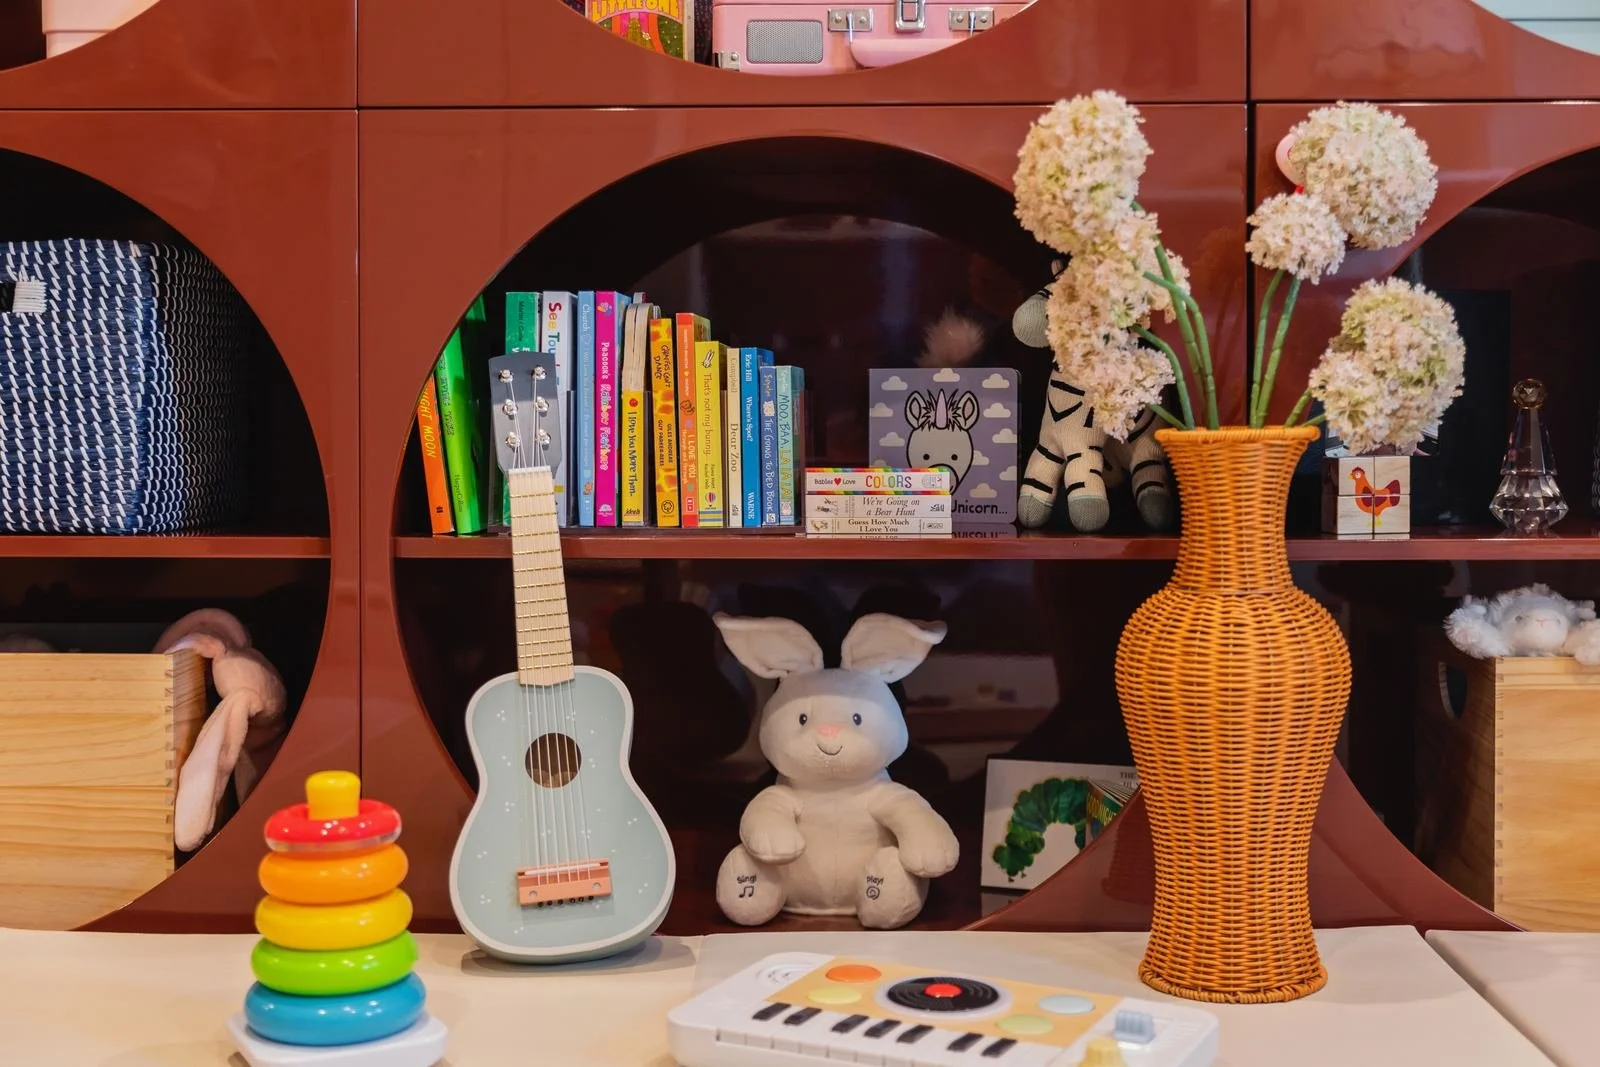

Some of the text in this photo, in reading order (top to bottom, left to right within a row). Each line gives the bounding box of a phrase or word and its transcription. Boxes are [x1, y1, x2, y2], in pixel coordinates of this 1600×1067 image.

[592, 0, 680, 24] LITTLE ONE
[582, 303, 593, 332] Church
[548, 302, 563, 367] See Tou
[653, 355, 663, 381] DANCE
[729, 357, 739, 393] Campbell
[745, 353, 753, 383] Eric Hill
[703, 372, 713, 396] That's
[600, 341, 612, 472] Peacock's Rainbow Feathers
[704, 398, 712, 412] not
[628, 416, 638, 434] Love
[702, 413, 712, 428] my
[745, 396, 755, 443] Where's Spot?
[764, 418, 774, 433] THE
[423, 425, 434, 459] MOON
[629, 435, 638, 449] You
[687, 440, 697, 461] LOVE
[730, 423, 740, 473] Dear Zoo
[764, 434, 775, 460] GOING
[628, 449, 639, 473] More
[688, 463, 697, 479] YOU
[765, 472, 775, 489] BED
[842, 478, 856, 486] Love
[865, 474, 912, 489] COLORS
[747, 491, 755, 520] WARNE
[766, 491, 775, 513] BOOK
[862, 497, 884, 507] We're
[886, 497, 908, 508] Going
[910, 499, 920, 507] on
[875, 508, 893, 516] Bear
[895, 508, 916, 516] Hunt
[848, 519, 869, 527] Guess
[890, 518, 910, 526] Much
[859, 525, 899, 533] I Love You
